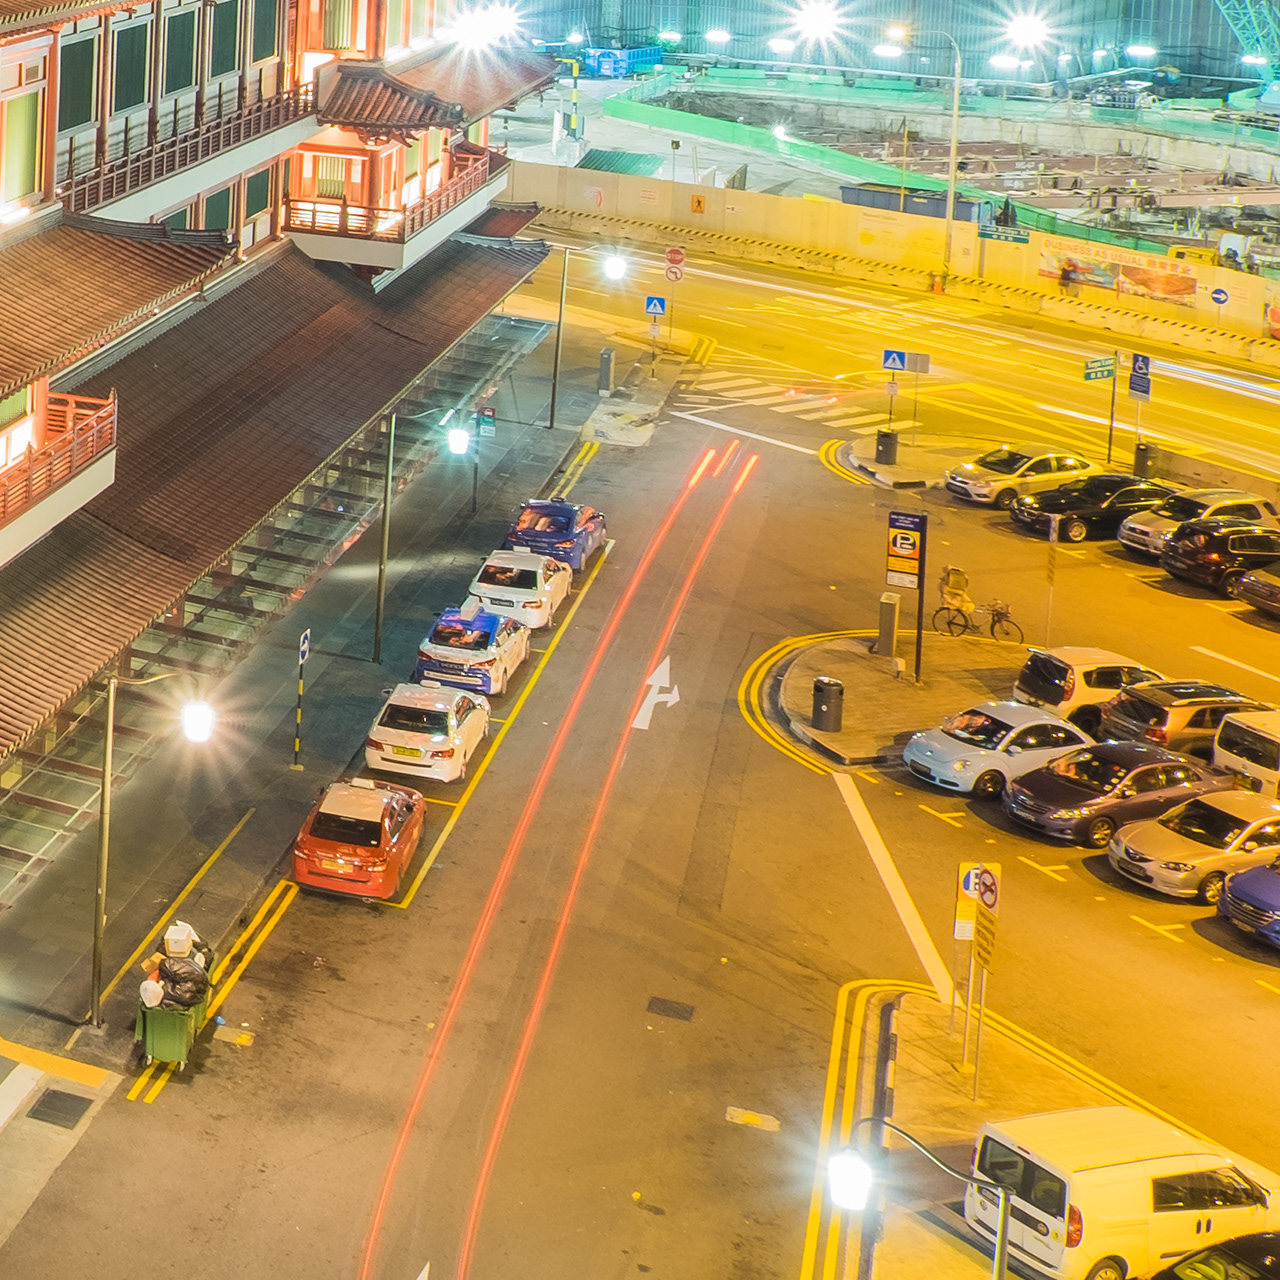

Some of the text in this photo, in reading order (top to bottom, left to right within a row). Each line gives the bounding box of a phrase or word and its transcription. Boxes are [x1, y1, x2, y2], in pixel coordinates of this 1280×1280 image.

[1044, 239, 1145, 266] BUSINESS AS USUAL
